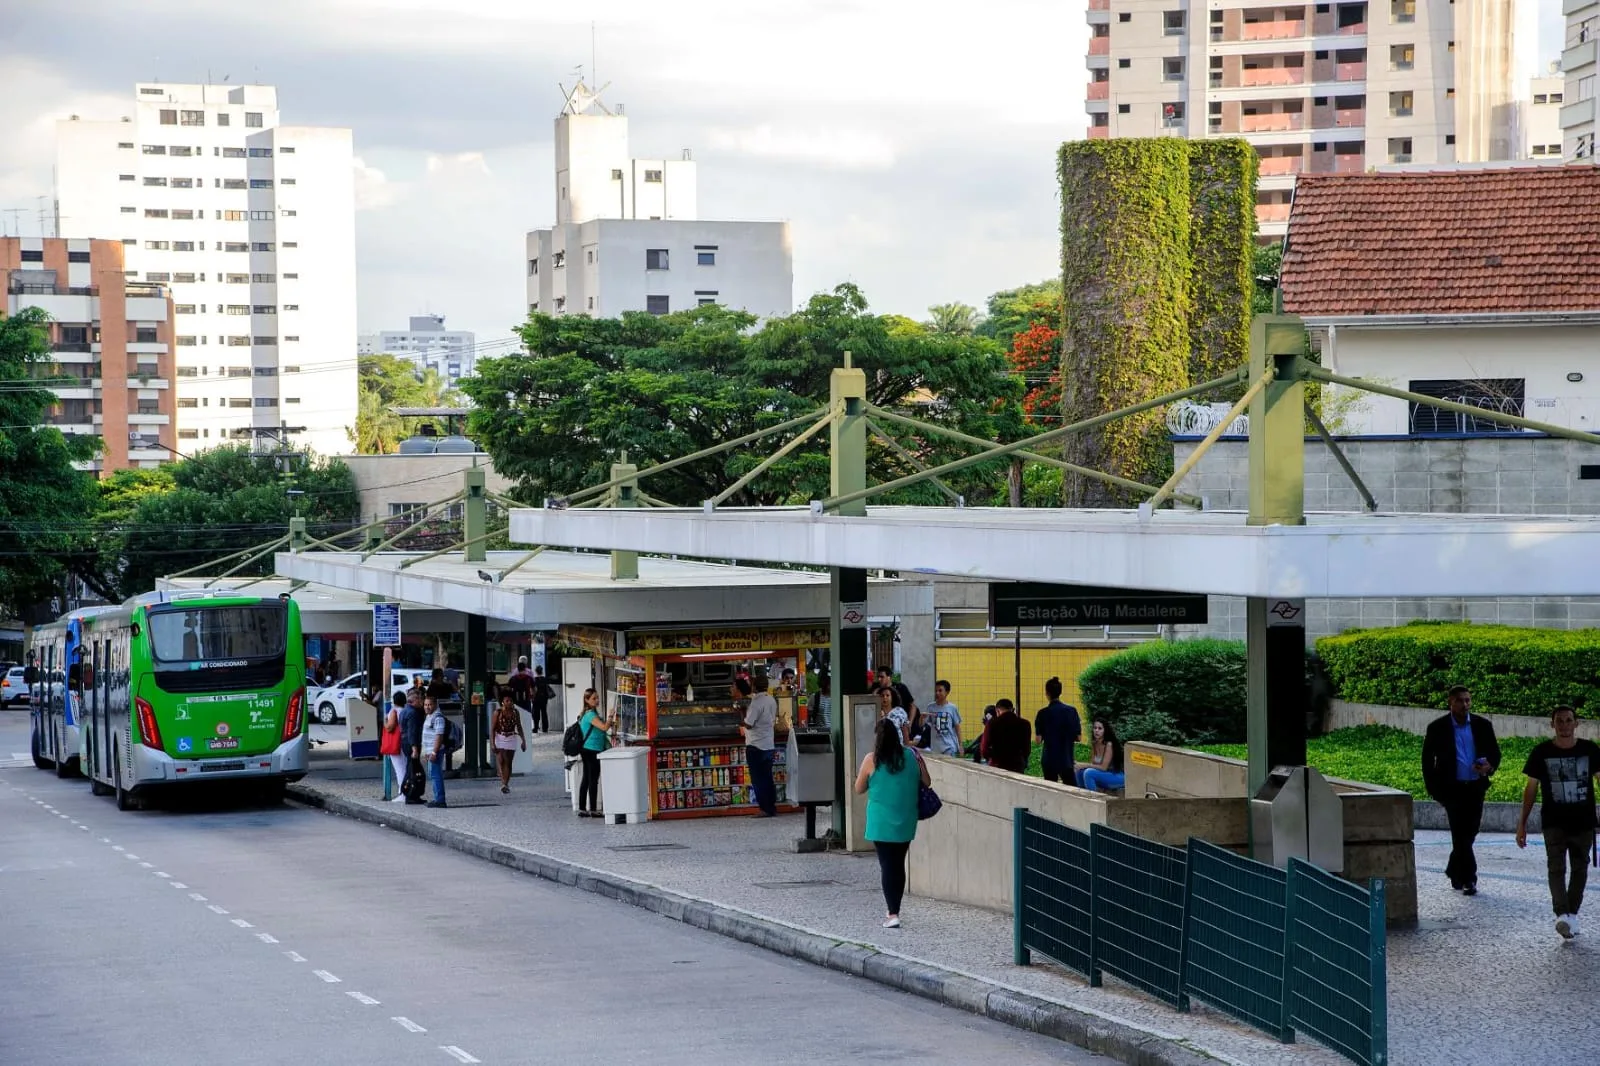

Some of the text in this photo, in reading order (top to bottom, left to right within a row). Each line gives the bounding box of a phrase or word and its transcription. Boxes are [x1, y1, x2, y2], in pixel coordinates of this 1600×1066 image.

[1017, 604, 1187, 621] Estação Vila Madalena
[704, 631, 759, 644] PAPAGAIO
[711, 640, 752, 650] DE BOTAS
[254, 698, 275, 708] 1491
